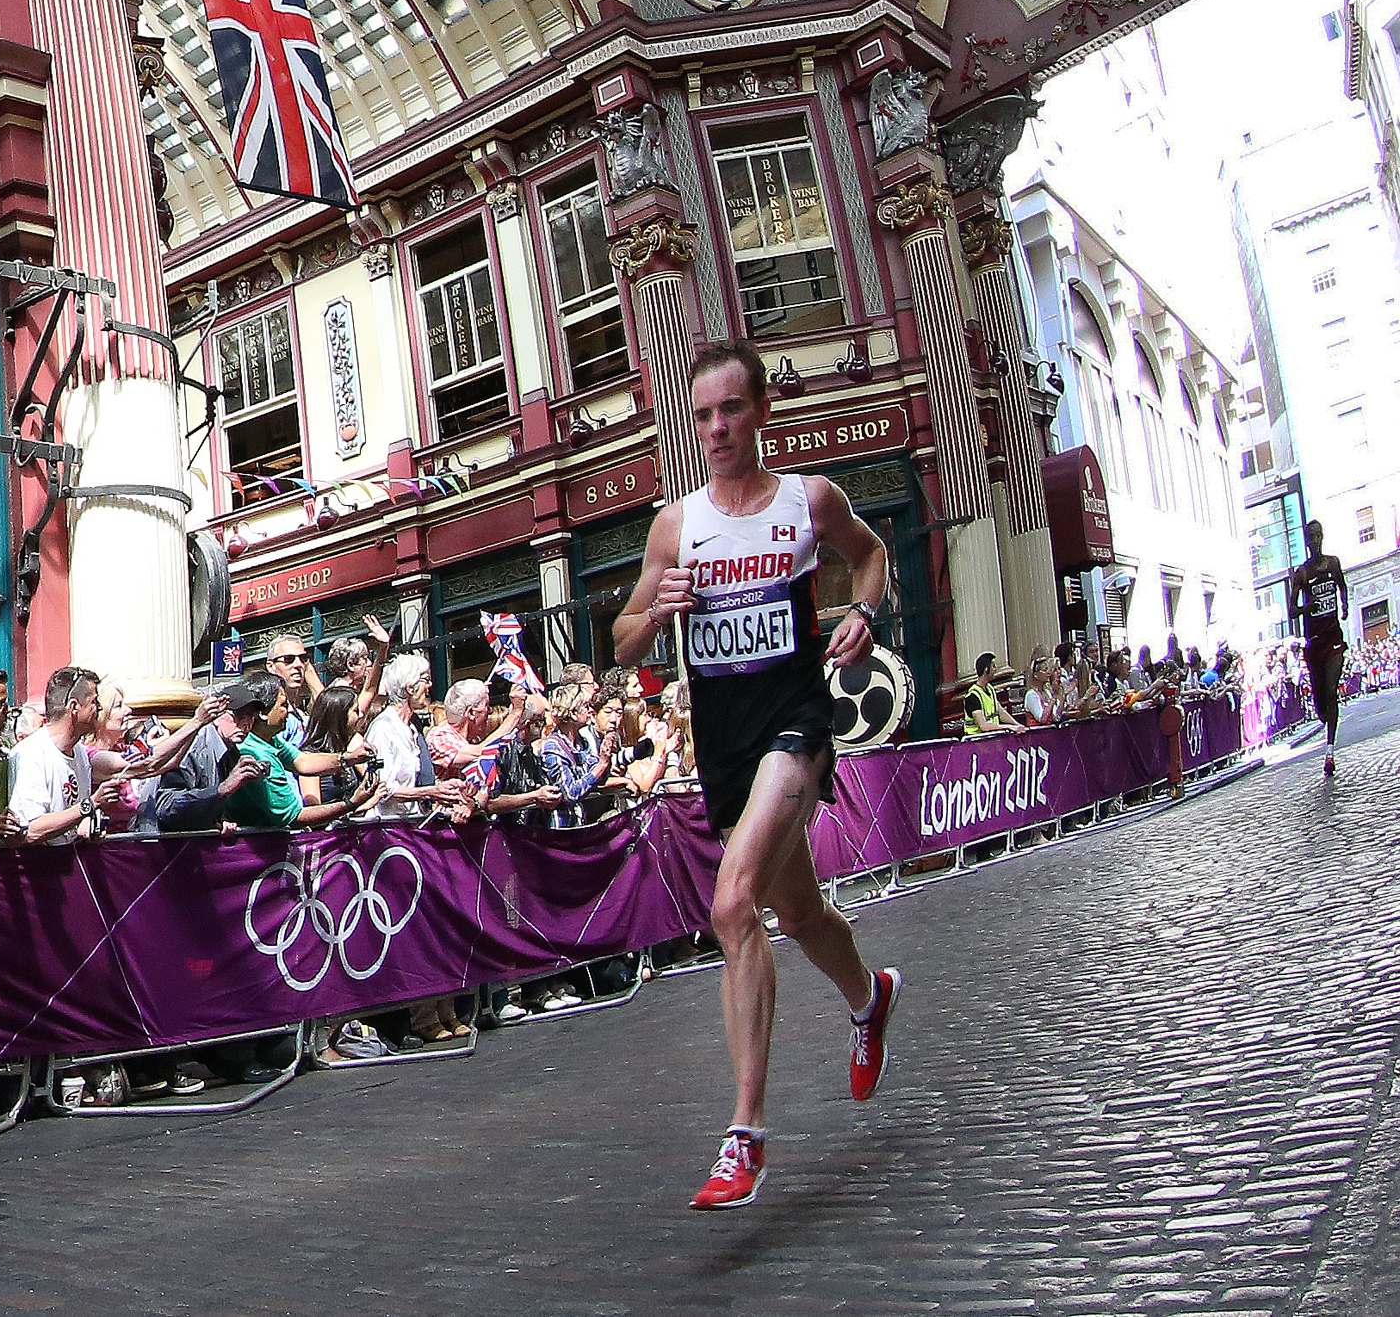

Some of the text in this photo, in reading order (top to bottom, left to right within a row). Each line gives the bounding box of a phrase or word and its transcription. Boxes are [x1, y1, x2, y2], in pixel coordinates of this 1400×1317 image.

[727, 196, 754, 209] WINE
[761, 158, 786, 246] BROKERS
[792, 186, 819, 199] WINE
[796, 197, 818, 209] BAR
[732, 207, 753, 219] BAR
[451, 282, 469, 367] BROKERS
[247, 324, 261, 400] BROKERS
[785, 430, 828, 453] PEN
[837, 419, 890, 444] SHOP
[586, 473, 637, 504] 8 & 9
[247, 582, 279, 604] PEN
[287, 567, 332, 593] SHOP
[696, 553, 795, 589] CANADA
[706, 590, 766, 611] London 2012
[691, 608, 790, 660] COOLSAET
[921, 745, 1051, 837] London 2012
